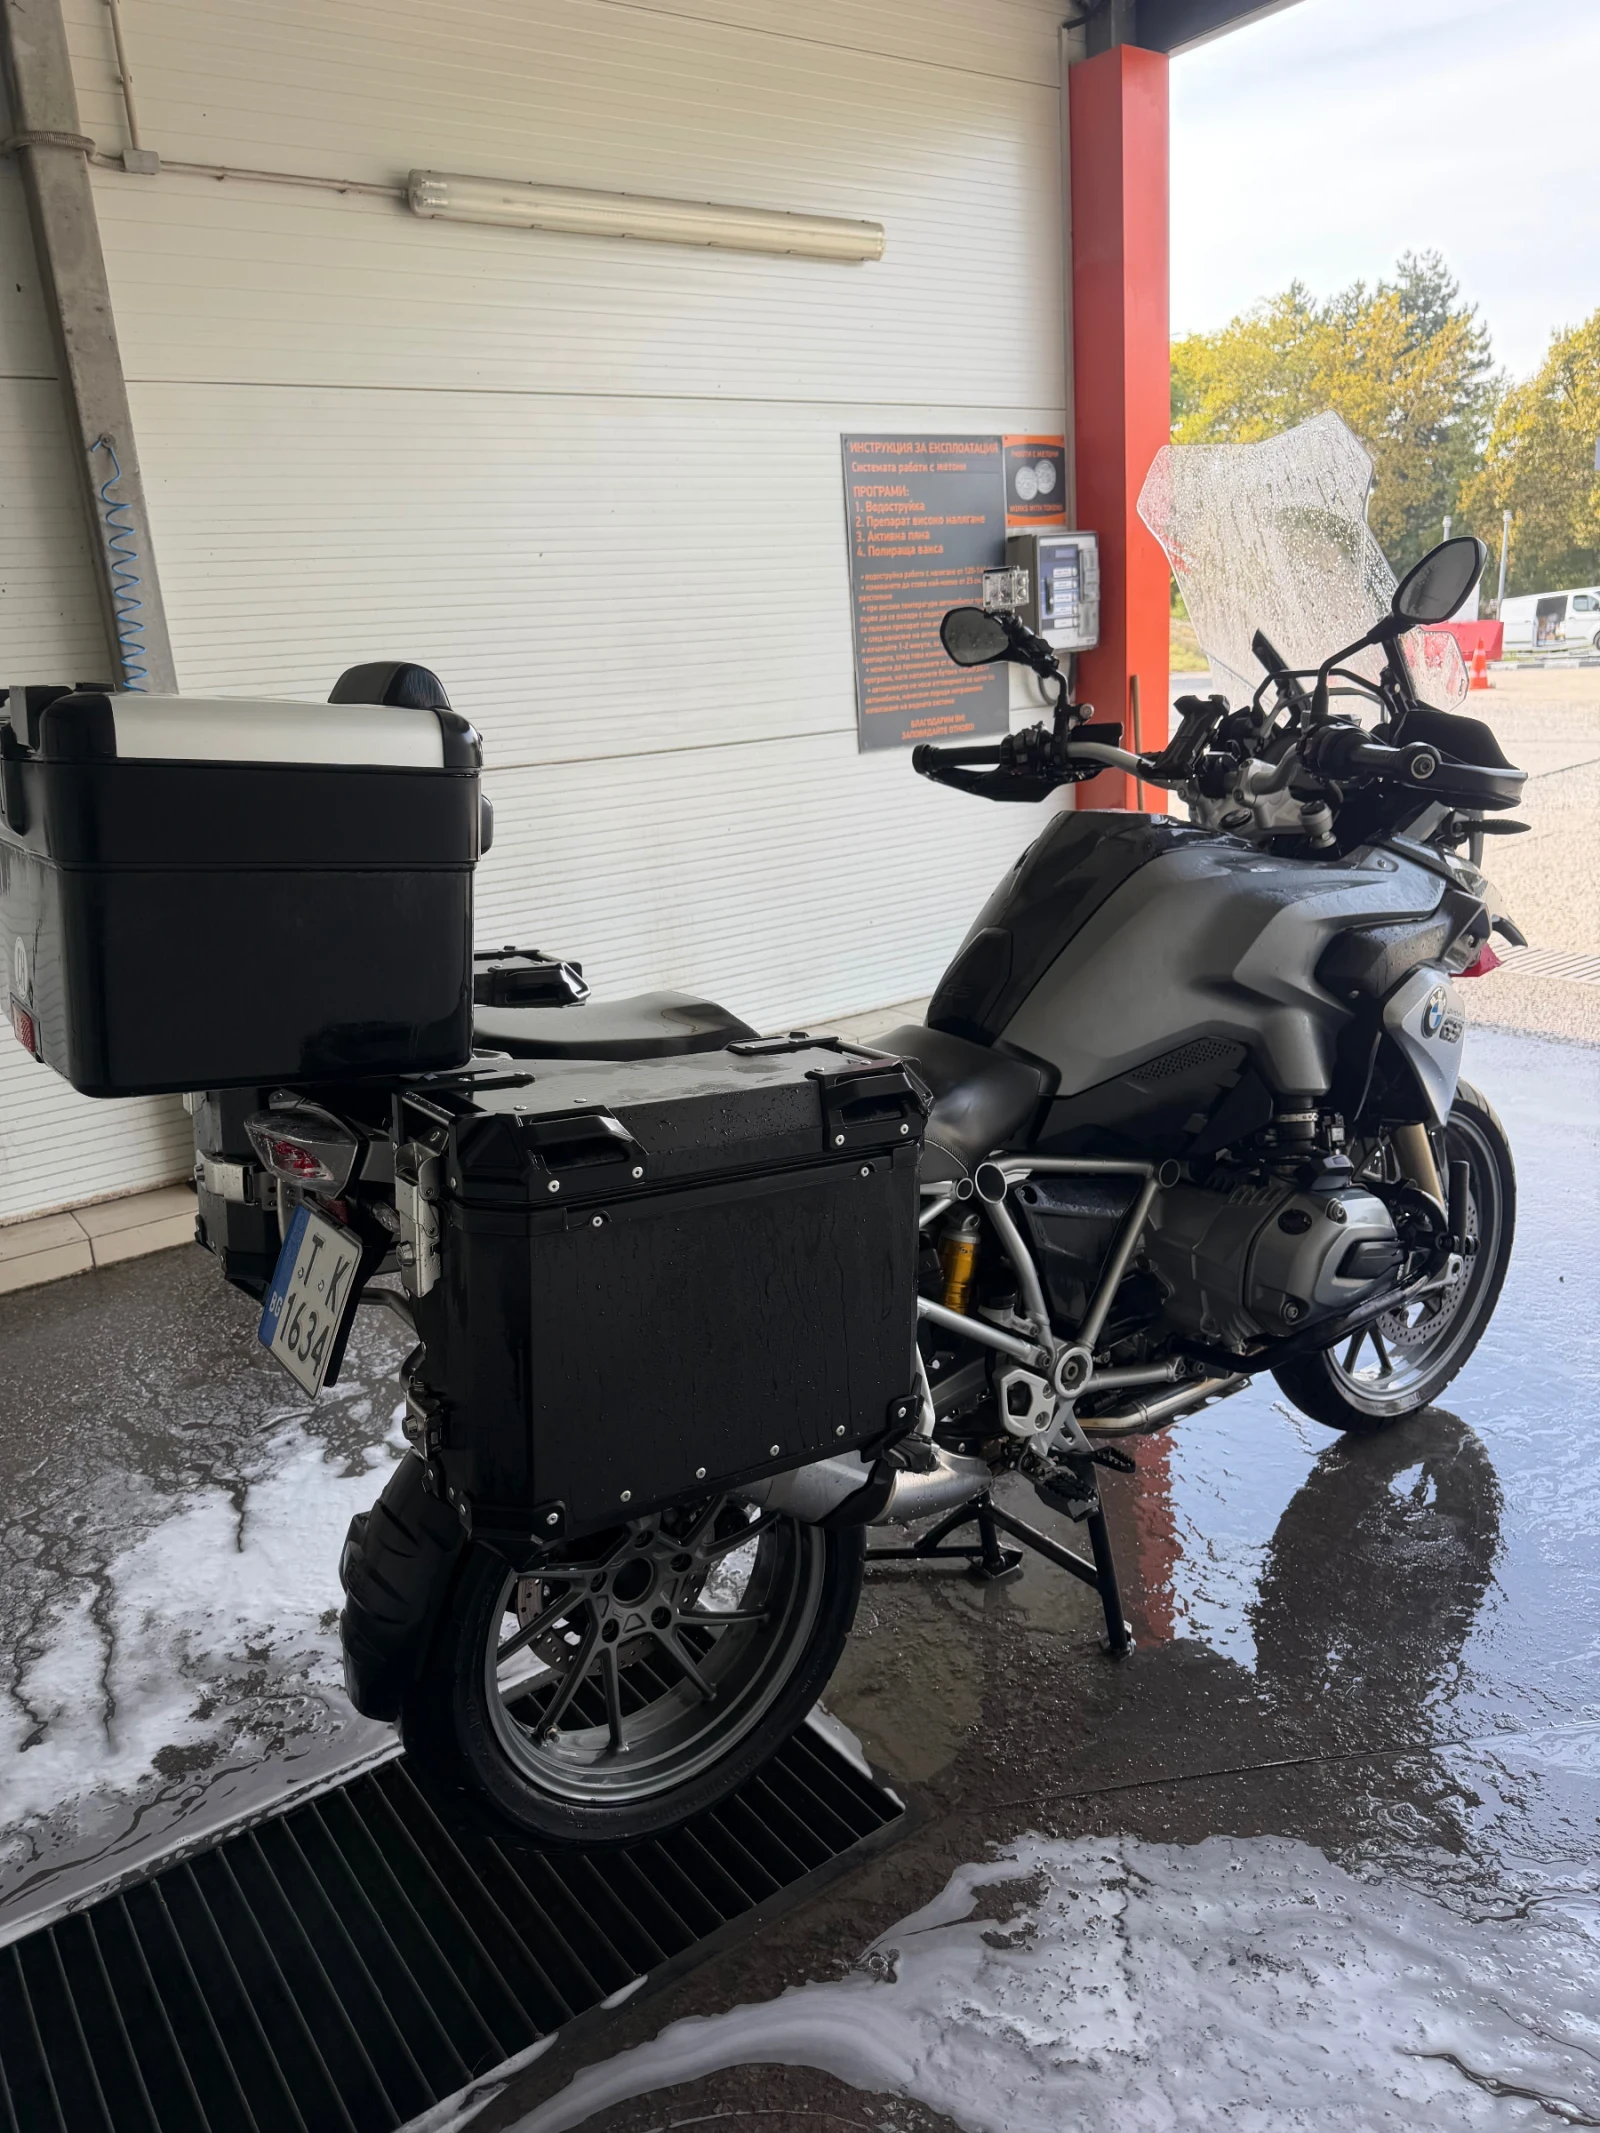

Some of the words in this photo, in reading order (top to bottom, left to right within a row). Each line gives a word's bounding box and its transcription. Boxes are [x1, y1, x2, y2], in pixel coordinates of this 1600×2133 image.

[850, 442, 913, 454] ИНСТРУКЦИЯ
[914, 442, 927, 454] ЗА
[929, 443, 998, 455] ЕКСПЛОАТАЦИЯ
[852, 462, 897, 473] Системата
[899, 461, 928, 474] работи
[853, 485, 909, 498] ПРОГРАМИ:
[856, 502, 864, 513] 1.
[865, 500, 925, 514] Водоструйка
[856, 517, 865, 528] 2.
[866, 516, 911, 529] Препарат
[912, 516, 944, 526] високо
[946, 514, 985, 525] налягане
[856, 532, 865, 542] 3.
[867, 531, 906, 542] Активна
[908, 531, 930, 541] пяна
[857, 547, 866, 557] 4.
[868, 546, 916, 558] Полираща
[918, 544, 944, 554] вакса
[268, 1291, 283, 1318] BG
[280, 1292, 330, 1377] 1634
